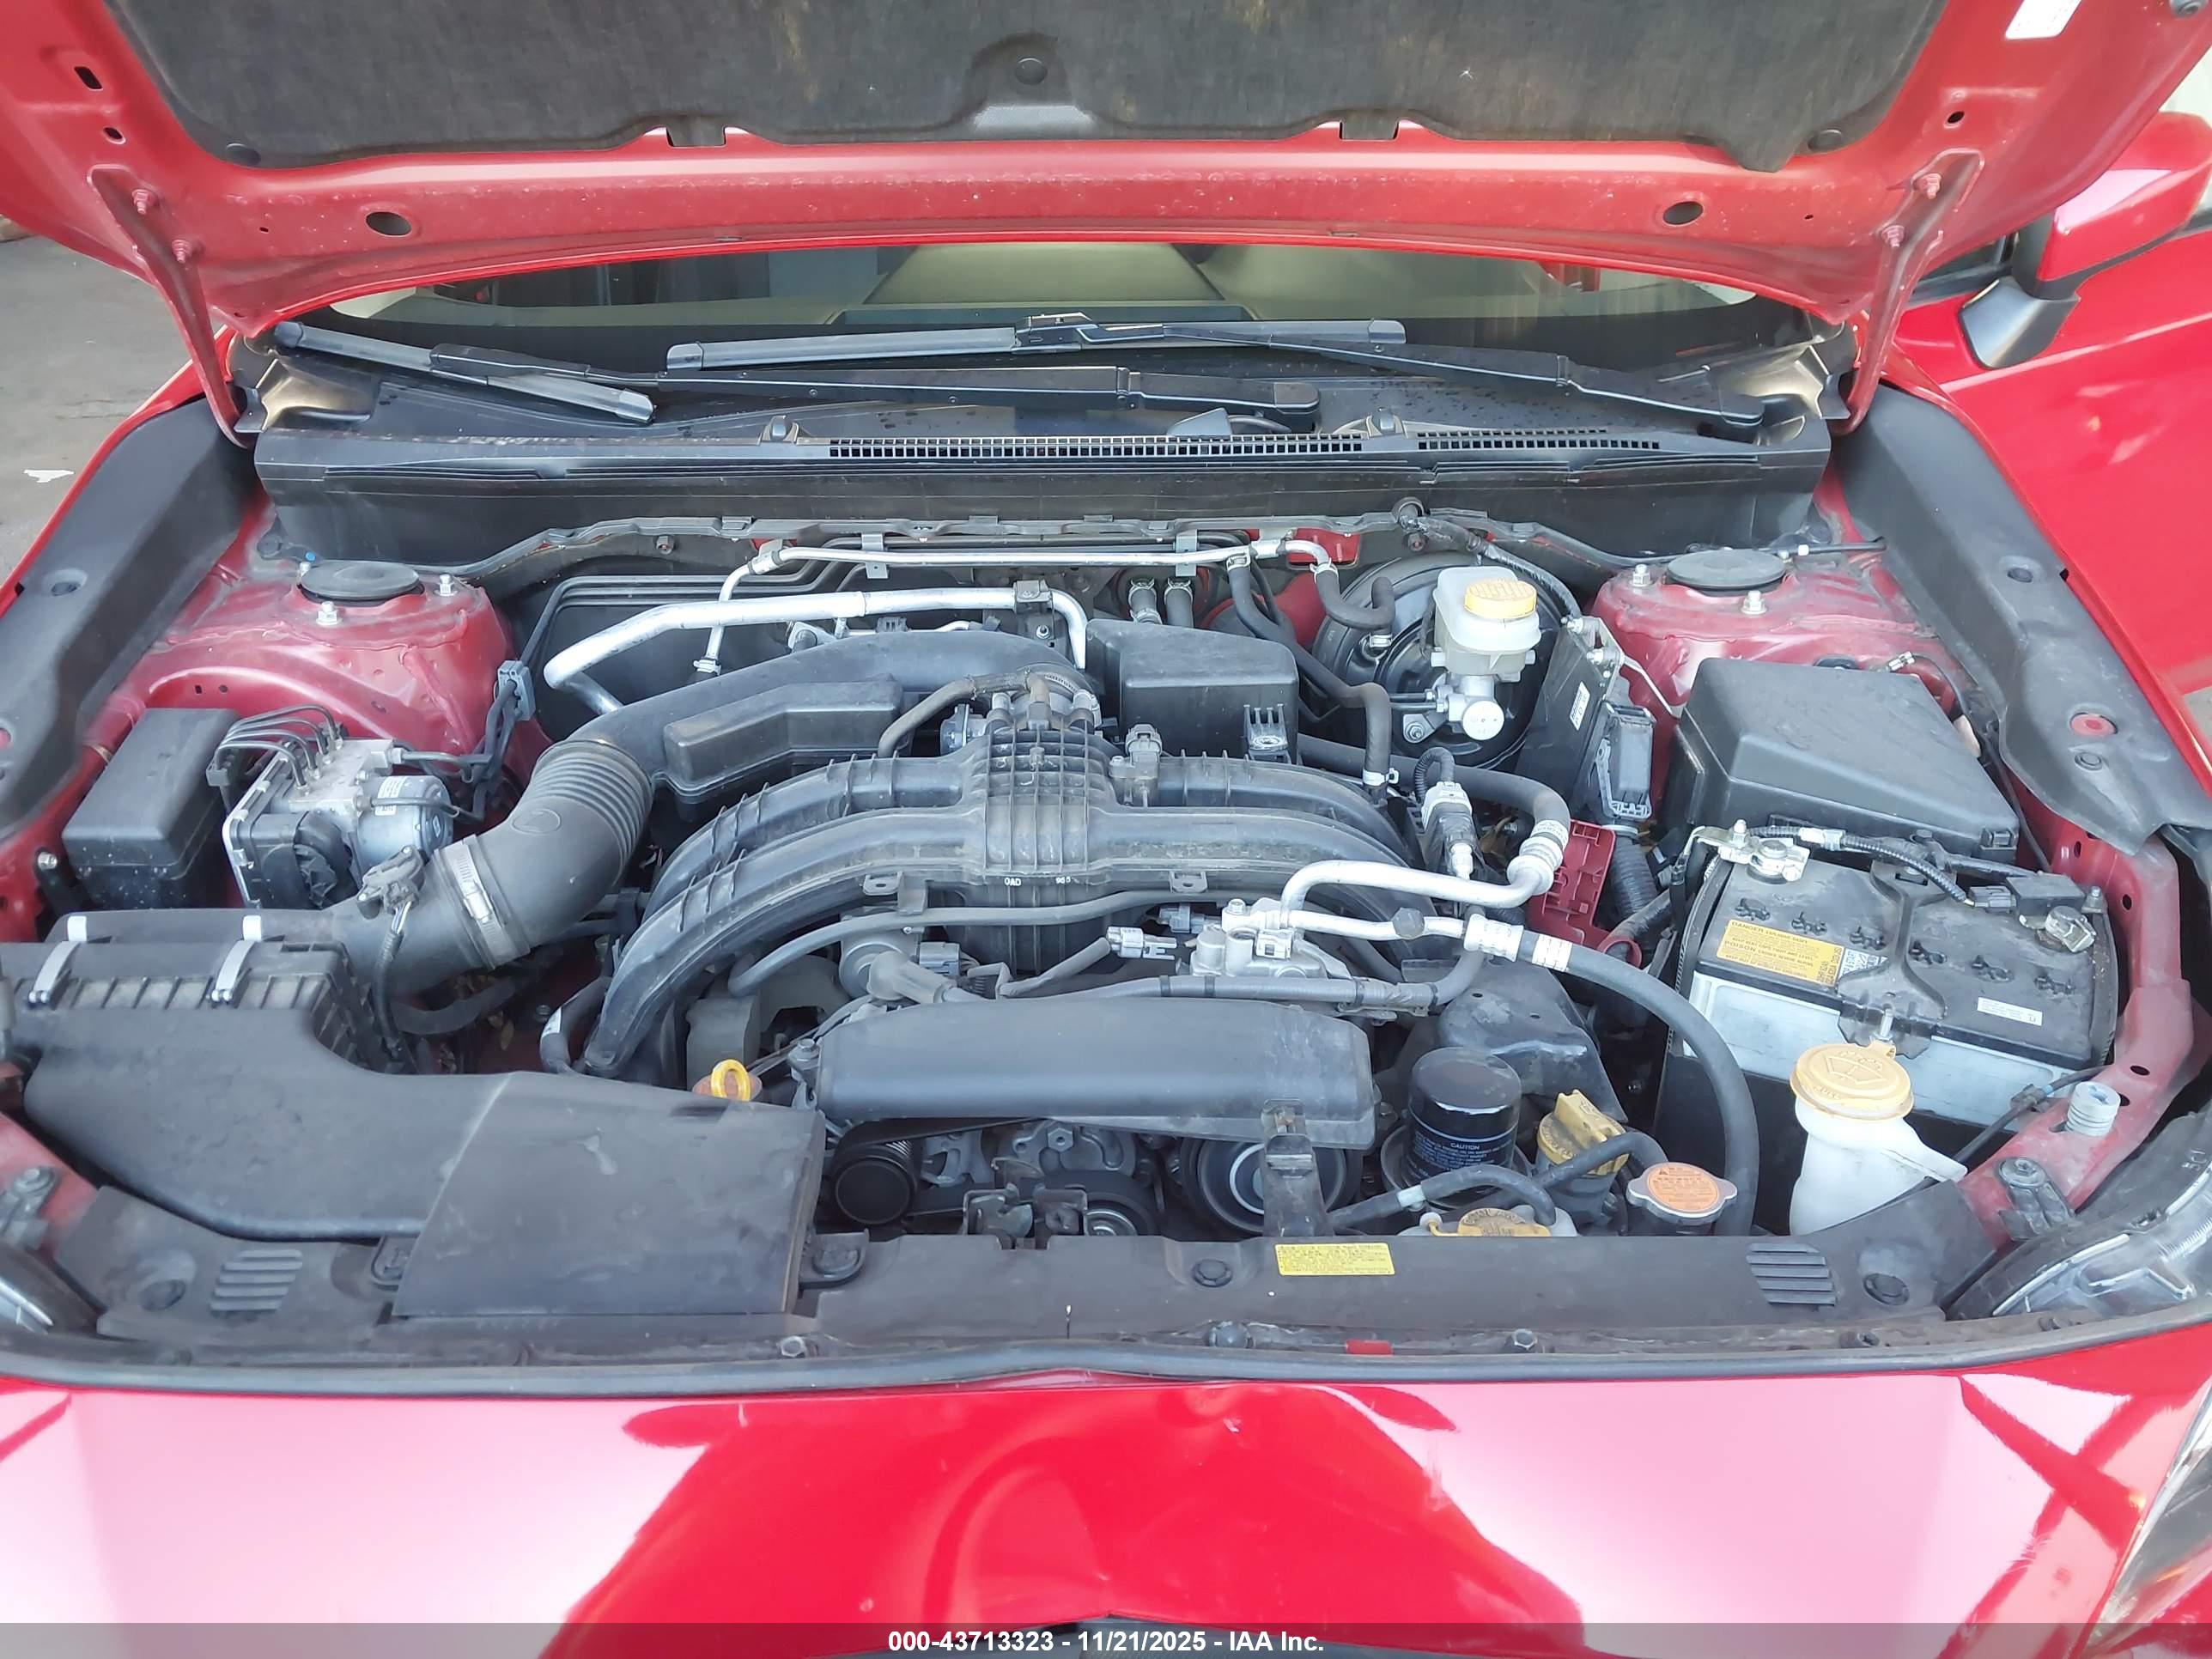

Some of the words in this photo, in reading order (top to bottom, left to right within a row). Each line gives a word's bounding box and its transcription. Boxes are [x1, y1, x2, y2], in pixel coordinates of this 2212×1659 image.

[1731, 921, 1764, 933] DANGER
[1724, 940, 1756, 952] POISON
[1450, 1142, 1480, 1151] CAUTION
